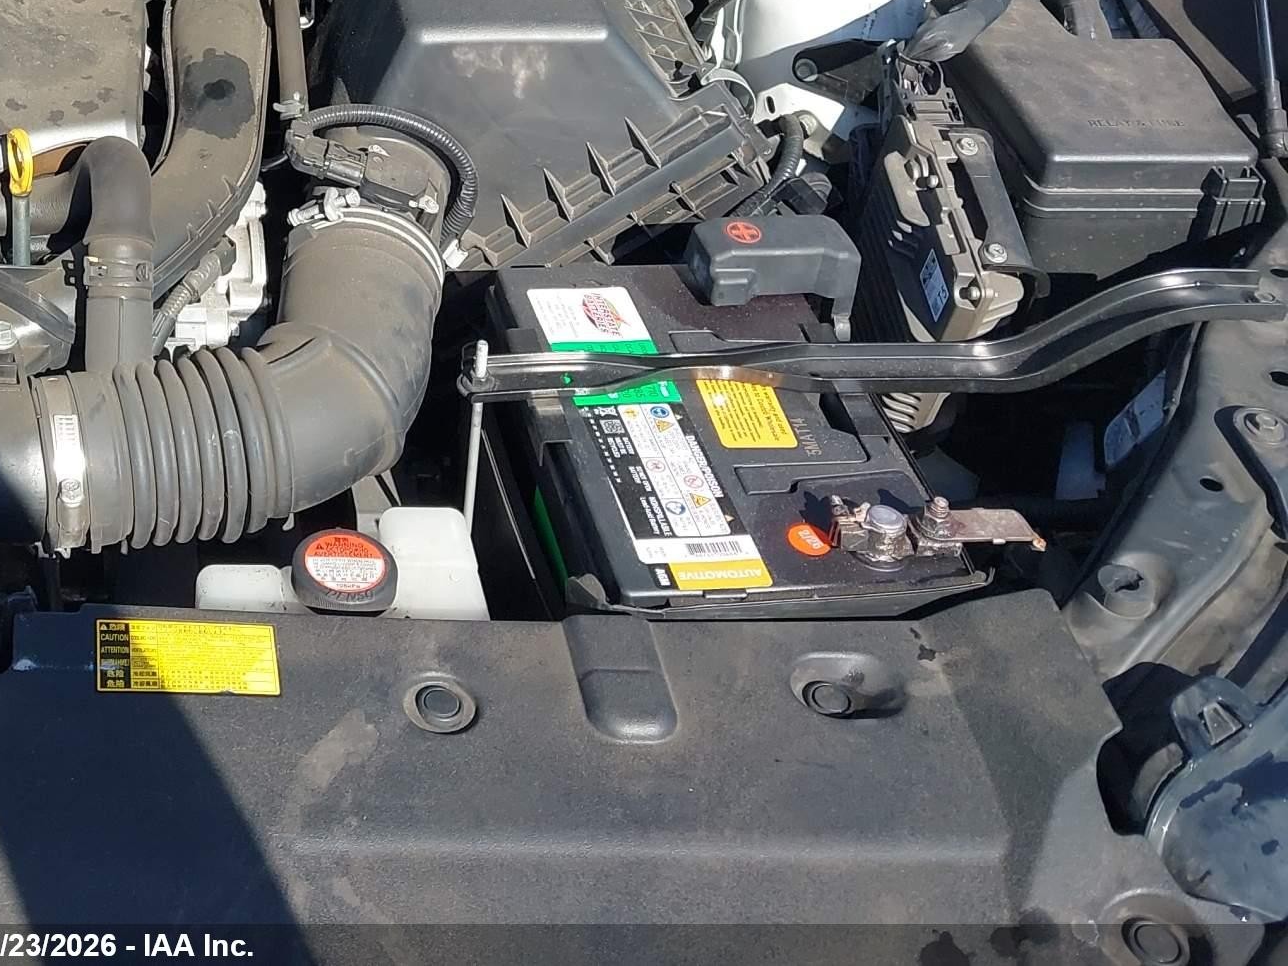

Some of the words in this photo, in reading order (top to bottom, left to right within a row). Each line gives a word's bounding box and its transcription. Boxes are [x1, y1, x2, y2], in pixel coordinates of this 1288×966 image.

[583, 294, 609, 335] BATTERIES
[593, 292, 622, 339] INTERSTATE
[790, 417, 822, 457] 5MAT14
[685, 435, 724, 498] DANGER/POISON
[654, 568, 672, 586] AGM
[679, 568, 762, 580] AUTOMOTIVE
[100, 634, 129, 642] CAUTION
[100, 646, 130, 654] ATTENTION
